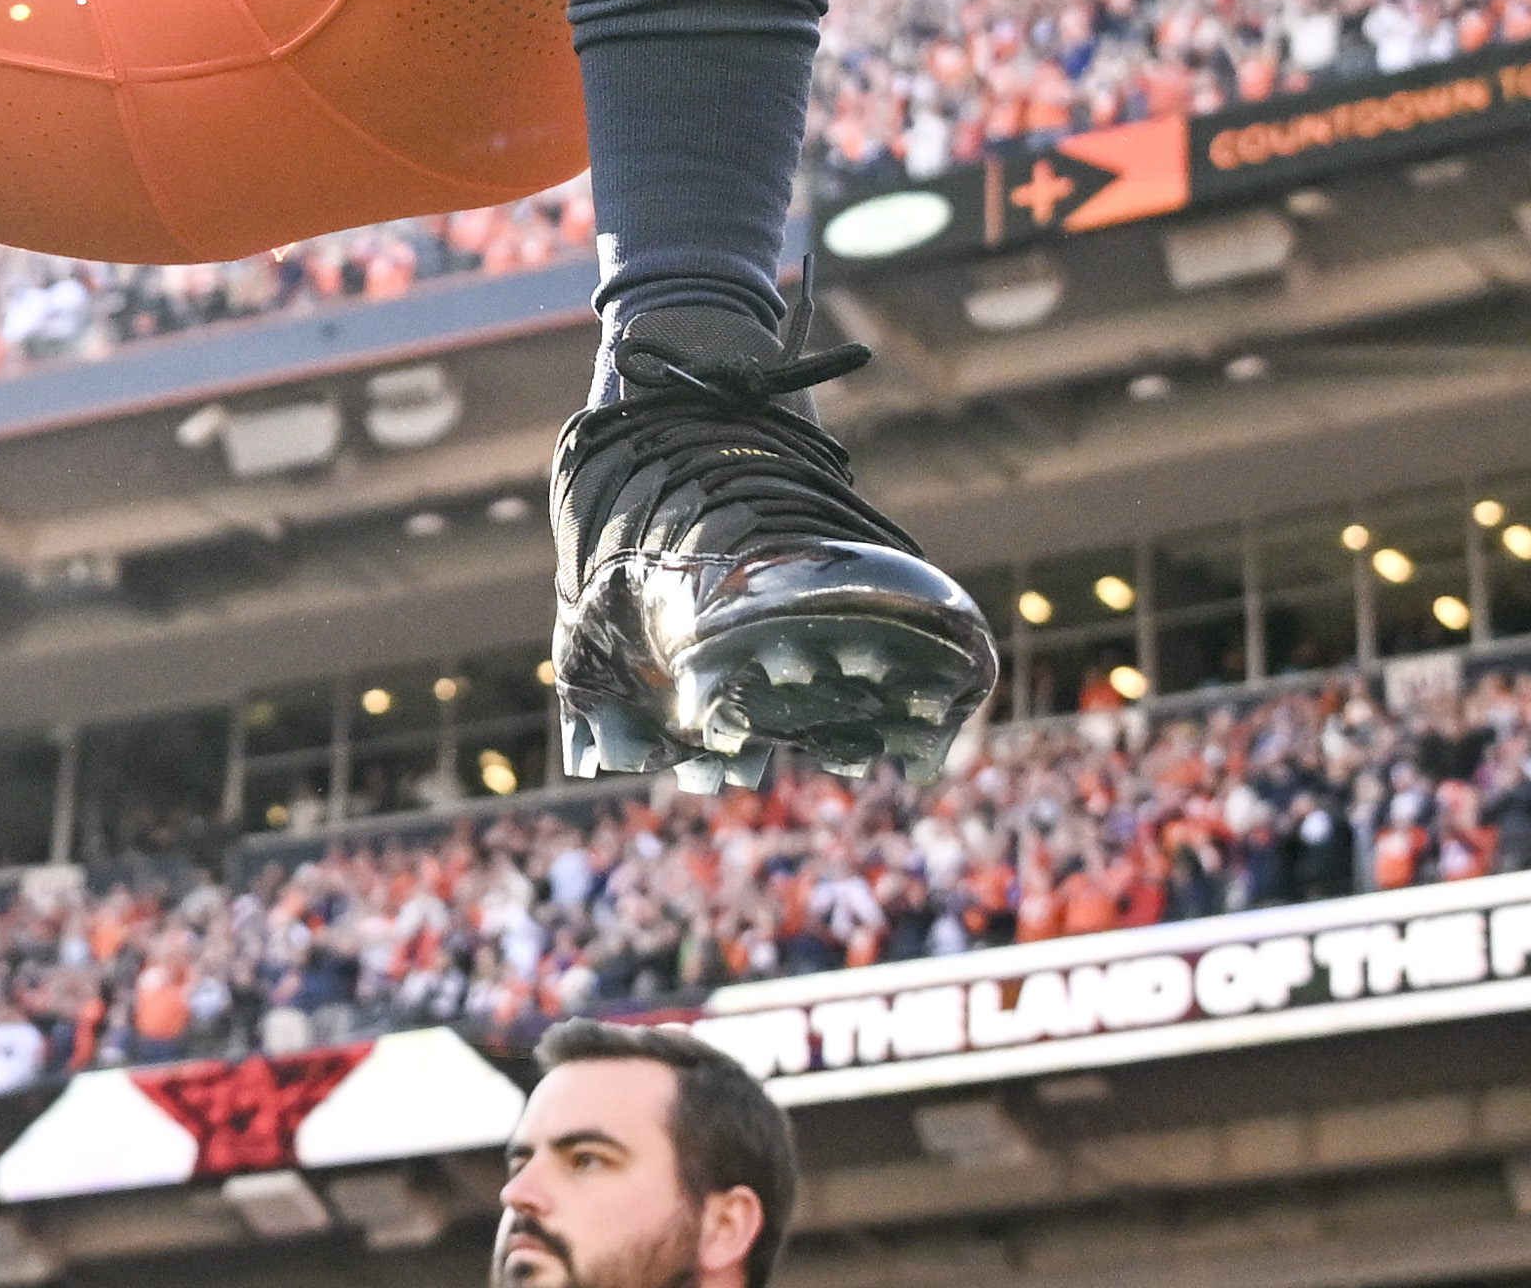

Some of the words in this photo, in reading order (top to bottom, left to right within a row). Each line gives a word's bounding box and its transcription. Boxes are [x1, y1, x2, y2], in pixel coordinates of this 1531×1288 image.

[1208, 78, 1491, 170] COUNTDOWN
[810, 984, 965, 1067] THE
[967, 954, 1194, 1049] LAND
[1195, 934, 1313, 1016] OF
[1312, 911, 1486, 999] THE
